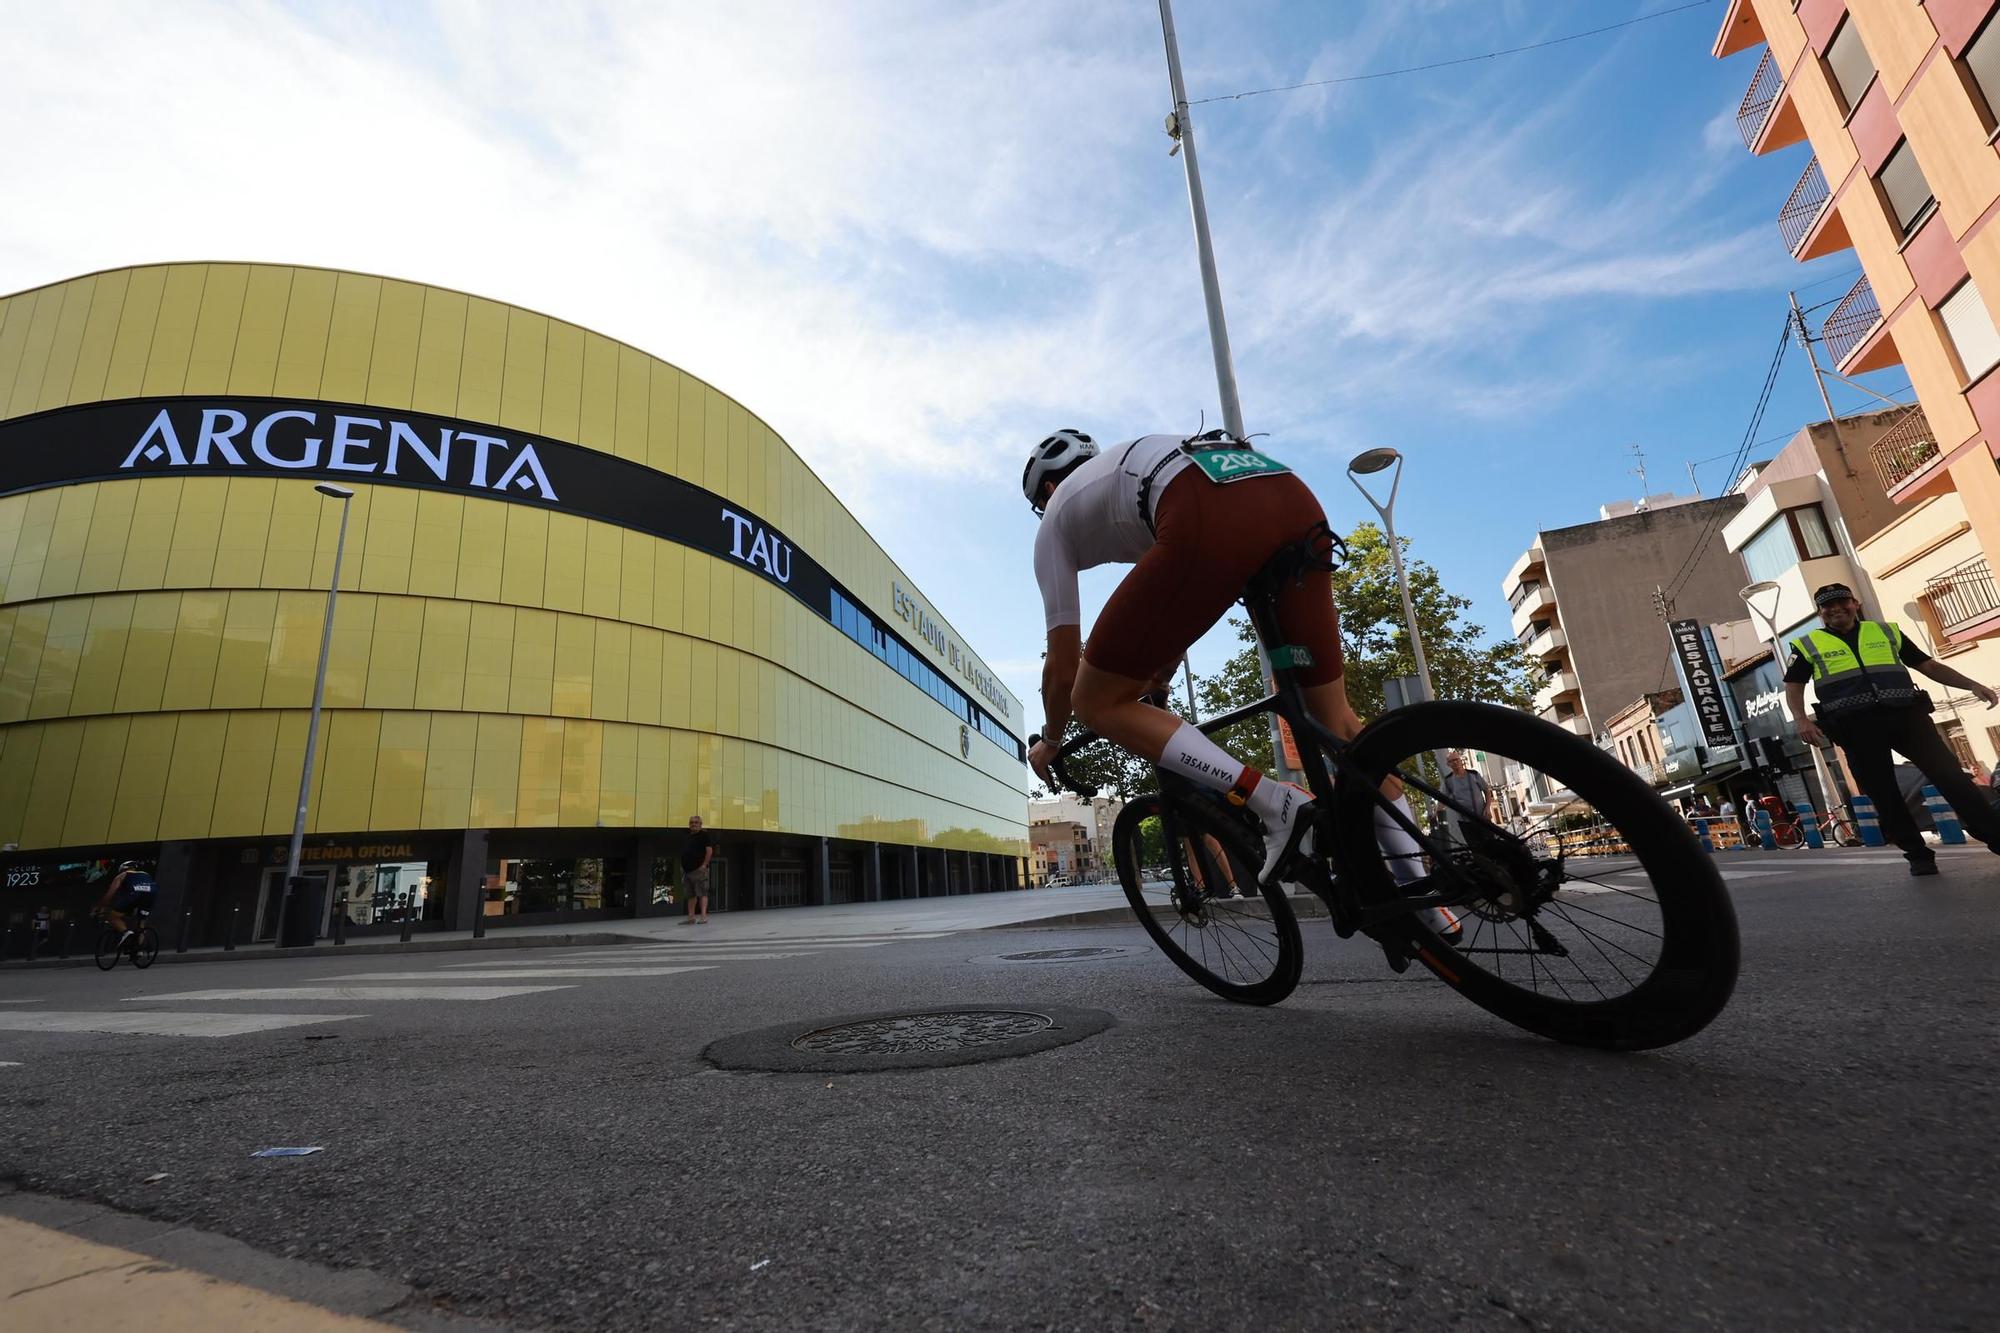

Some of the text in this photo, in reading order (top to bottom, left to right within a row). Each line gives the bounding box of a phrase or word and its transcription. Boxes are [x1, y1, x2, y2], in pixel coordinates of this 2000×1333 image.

[120, 408, 559, 502] ARGENTA
[1210, 453, 1268, 472] 203
[721, 507, 792, 583] TAU
[892, 581, 945, 656] ESTADIO
[949, 640, 960, 672] DE
[962, 655, 974, 685] LA
[1680, 633, 1725, 732] RESTAURANTE
[1180, 752, 1233, 783] VAN RYSEL
[301, 844, 414, 860] TIENDA OFICIAL
[6, 872, 40, 888] 1923
